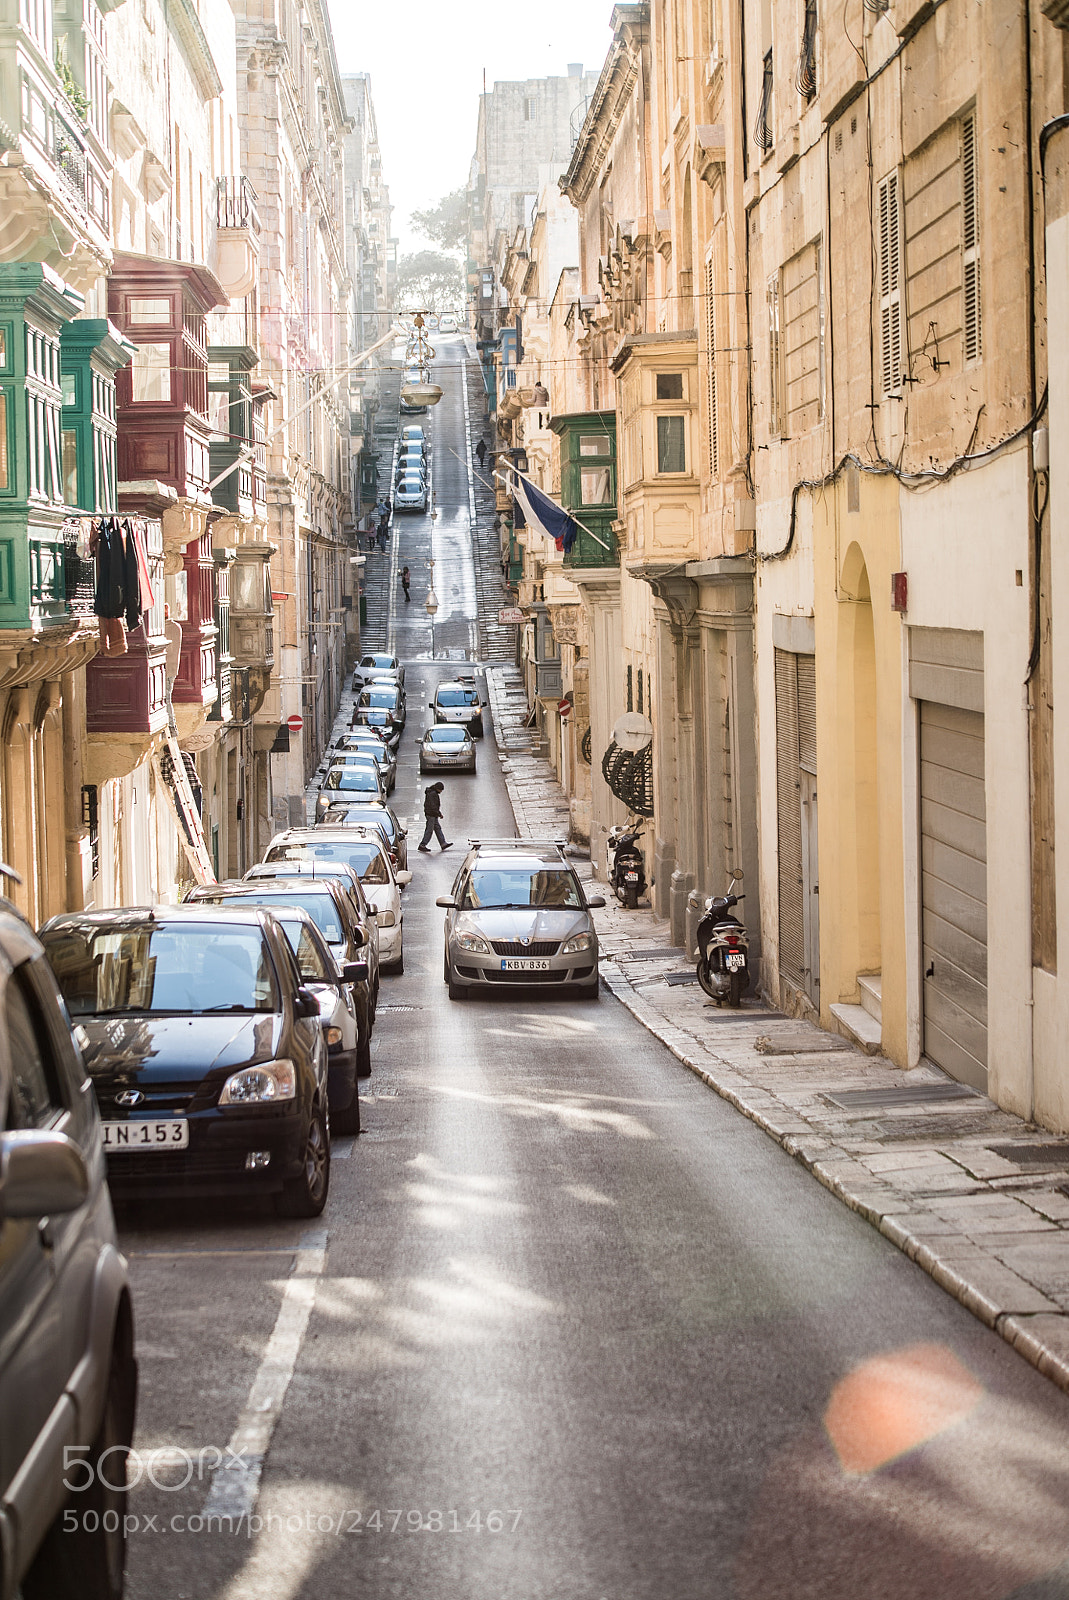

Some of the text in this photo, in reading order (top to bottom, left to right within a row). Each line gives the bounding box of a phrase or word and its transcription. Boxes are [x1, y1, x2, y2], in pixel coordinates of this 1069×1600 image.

[507, 961, 547, 969] KBV 836
[140, 1123, 183, 1143] 153
